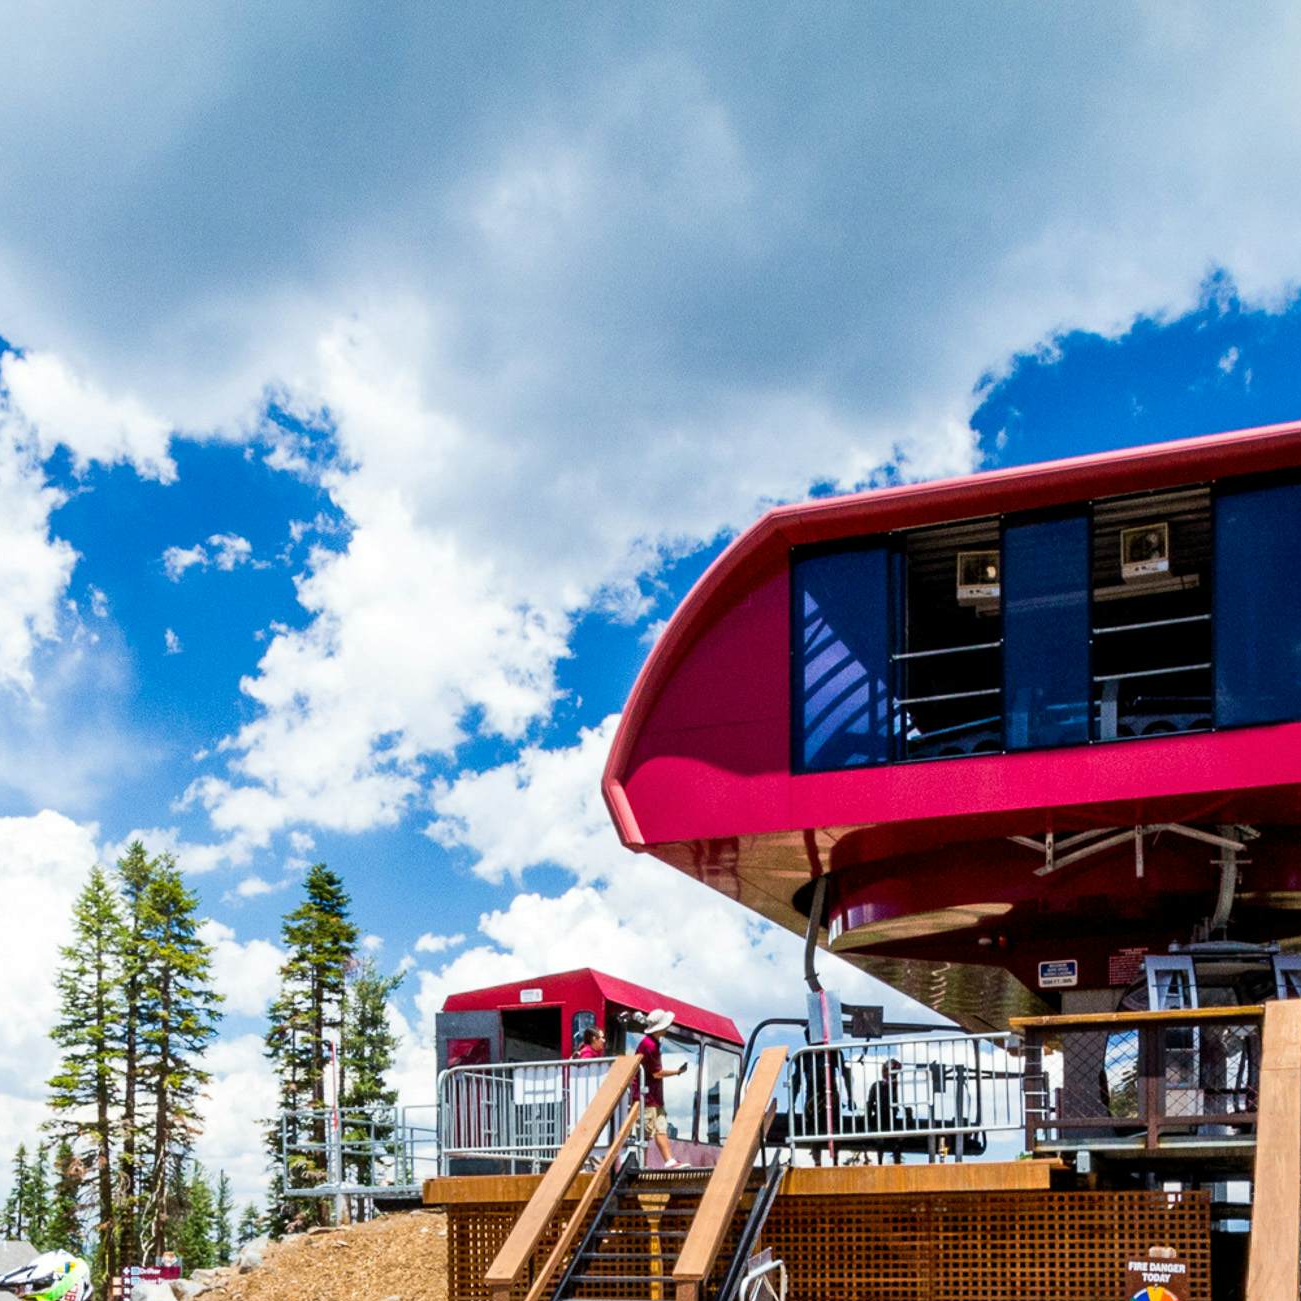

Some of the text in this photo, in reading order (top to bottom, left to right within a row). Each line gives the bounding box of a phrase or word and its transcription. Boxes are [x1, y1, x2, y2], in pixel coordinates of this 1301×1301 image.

[1128, 1261, 1186, 1273] FIRE DANGER
[1142, 1273, 1171, 1283] TODAY
